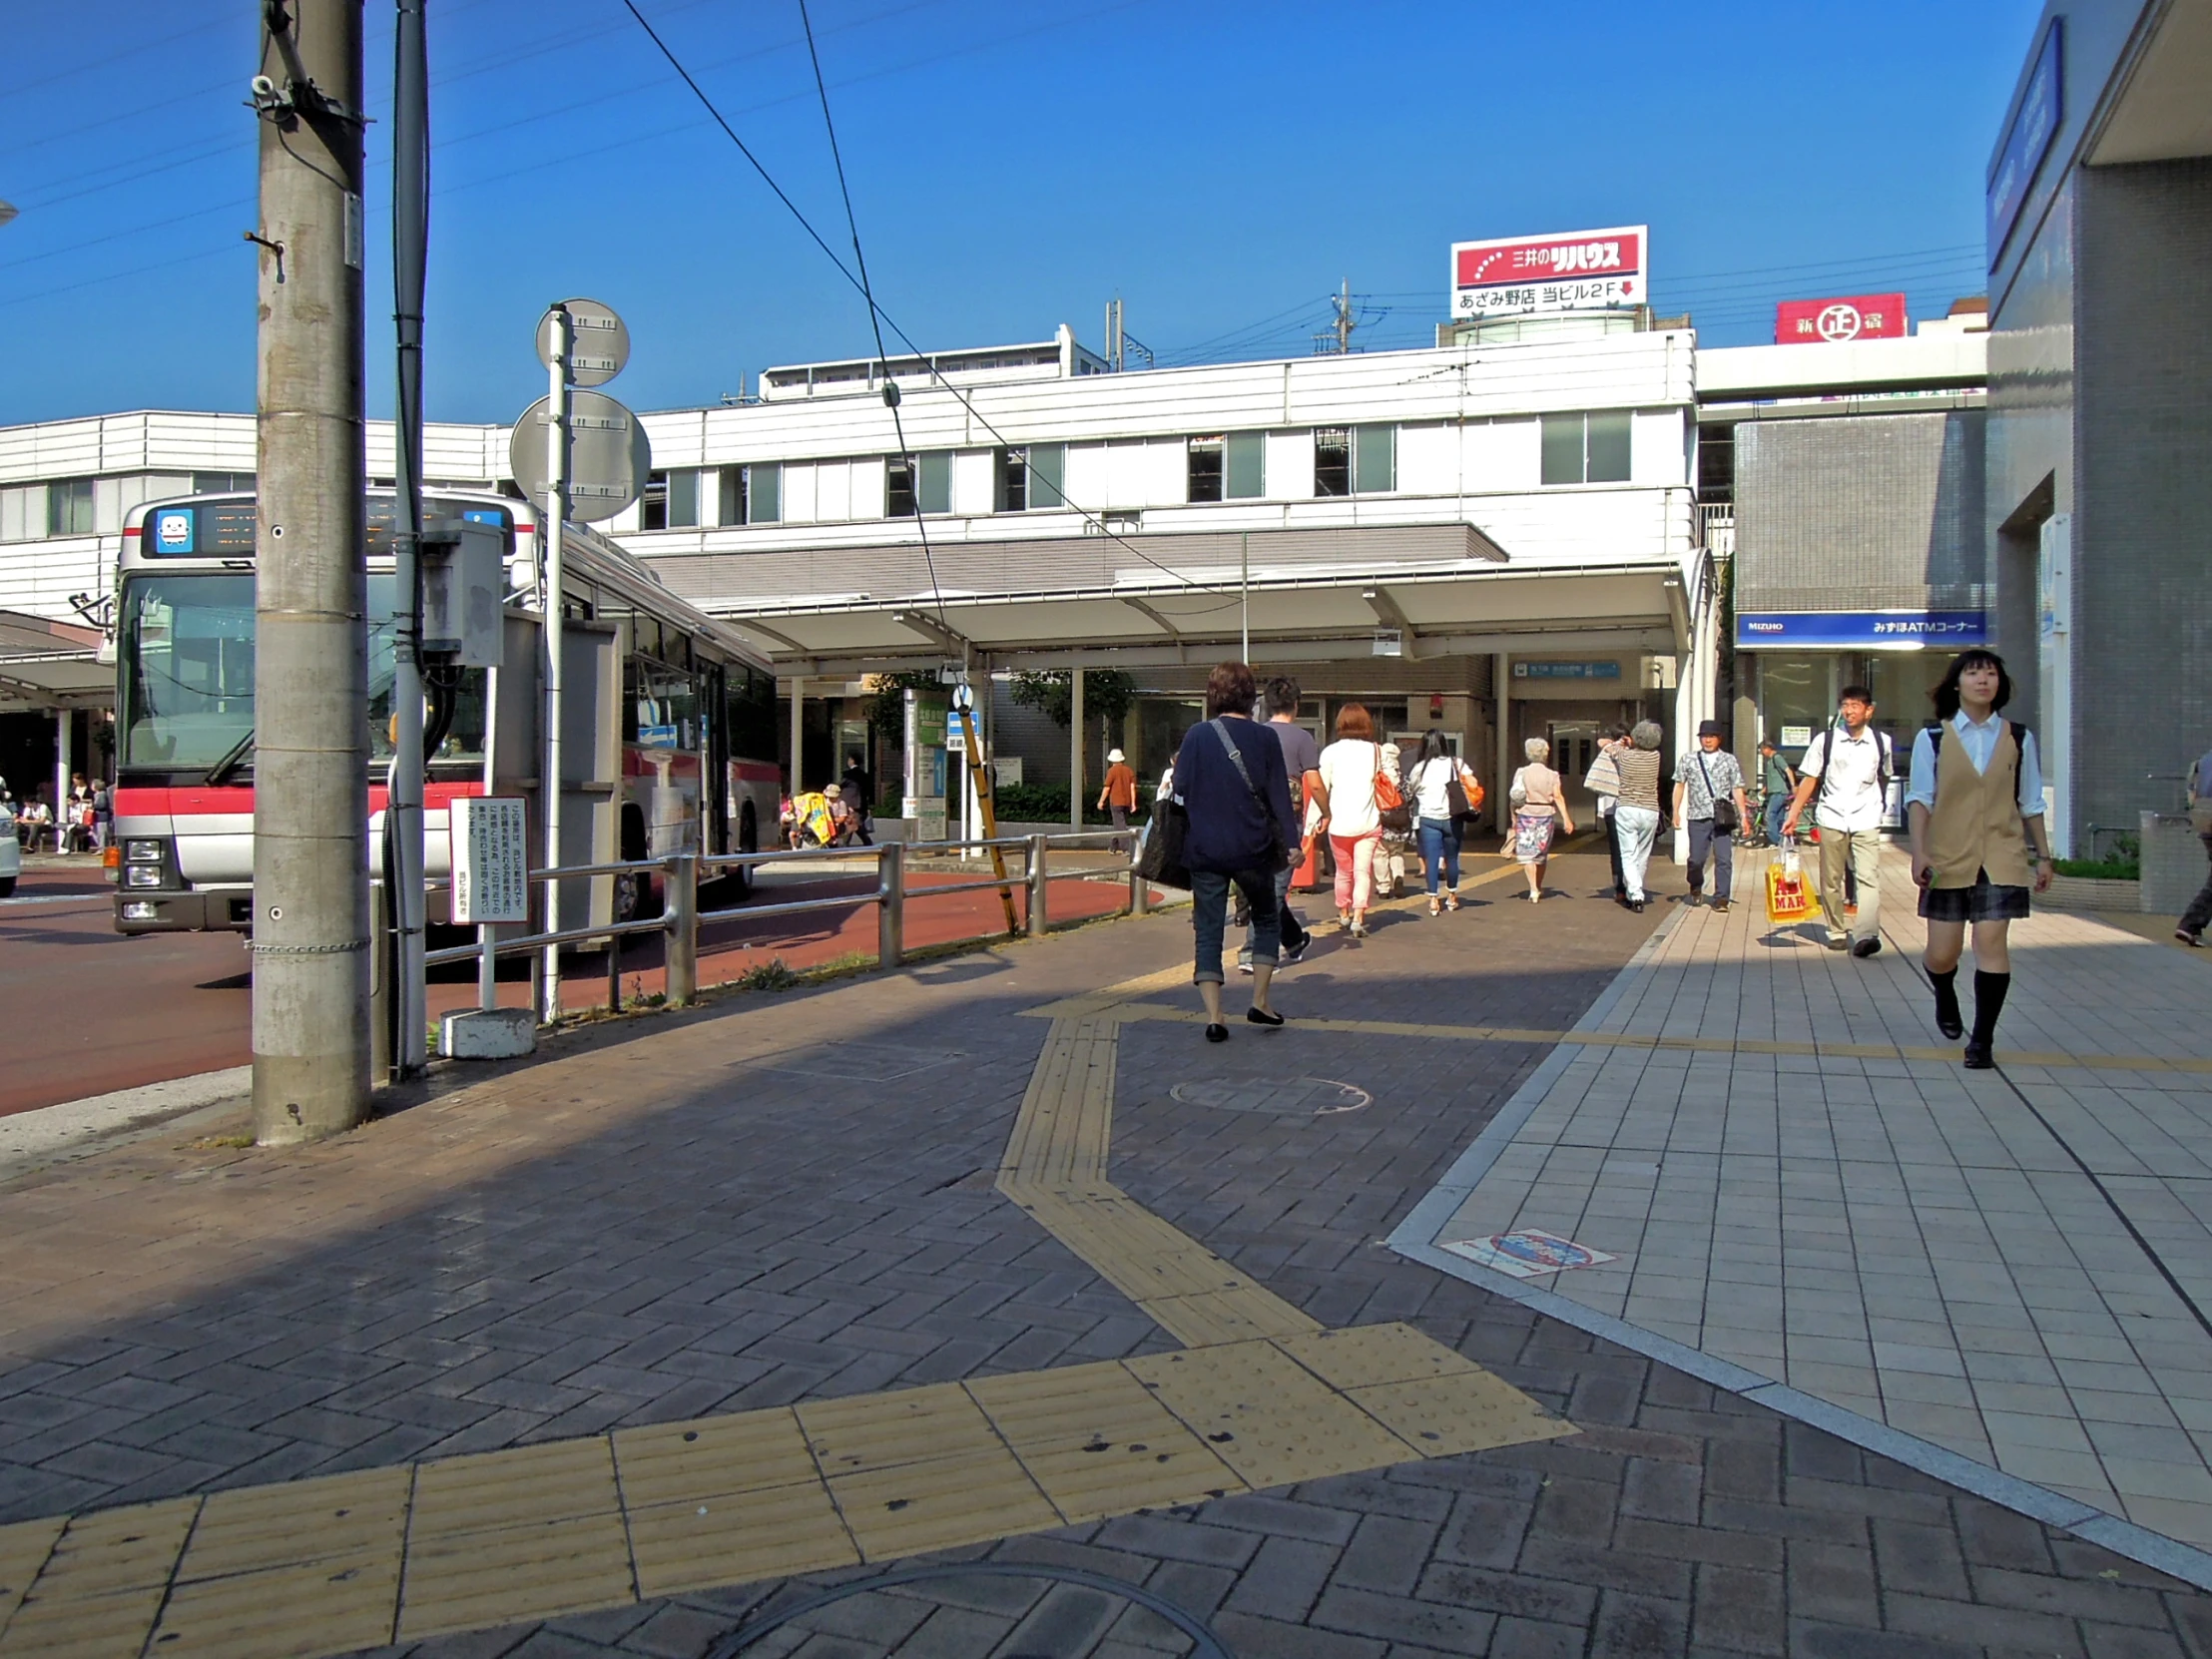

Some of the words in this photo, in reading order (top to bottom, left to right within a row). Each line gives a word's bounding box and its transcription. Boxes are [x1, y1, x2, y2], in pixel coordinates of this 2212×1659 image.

[1512, 242, 1621, 273] 三井のリハウス
[1459, 288, 1535, 308] あざみ野店
[1542, 282, 1616, 303] 当ビル2F
[1797, 318, 1814, 333] 新
[1865, 312, 1883, 329] 宿
[1748, 622, 1784, 631] MIZUHO
[1874, 622, 1977, 633] みずほATMコーナー
